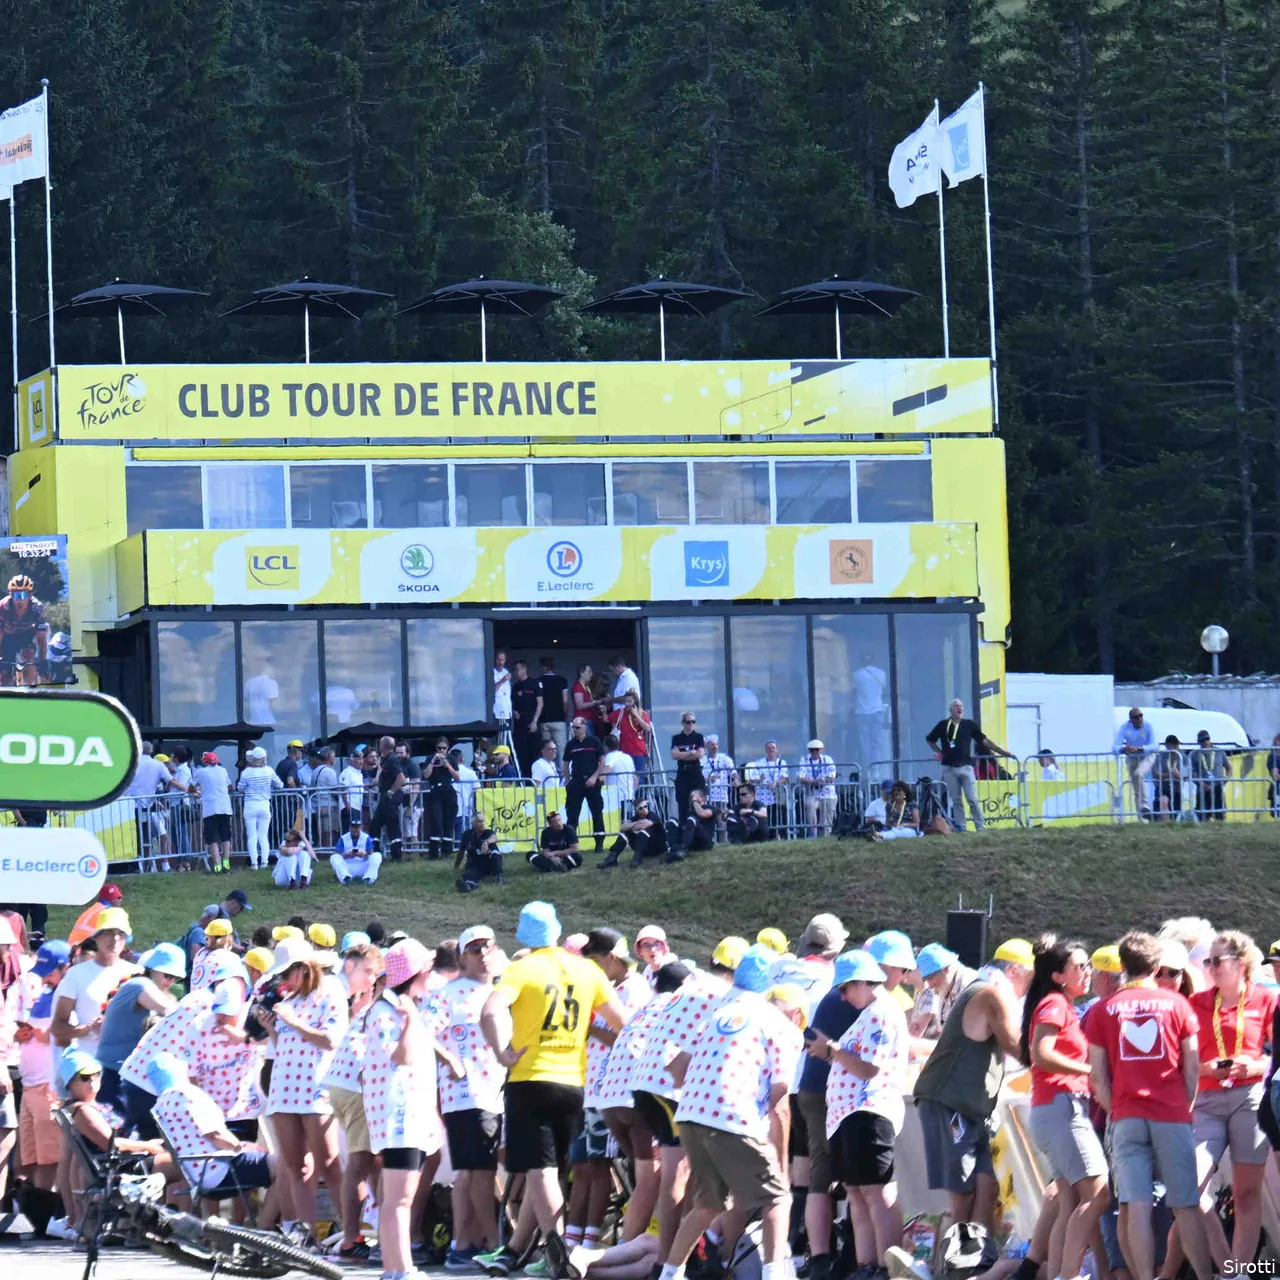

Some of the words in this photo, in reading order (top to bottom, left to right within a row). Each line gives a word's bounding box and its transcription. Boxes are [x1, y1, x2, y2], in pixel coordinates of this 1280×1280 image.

[178, 383, 271, 418] CLUB
[282, 382, 382, 417] TOUR
[394, 382, 440, 417] DE
[451, 380, 598, 417] FRANCE
[252, 555, 297, 571] LCL
[690, 556, 723, 574] Krys
[397, 582, 440, 593] ŠKODA
[536, 581, 594, 592] E.Leclerc
[1, 858, 76, 874] E.Leclerc
[541, 984, 580, 1033] 26
